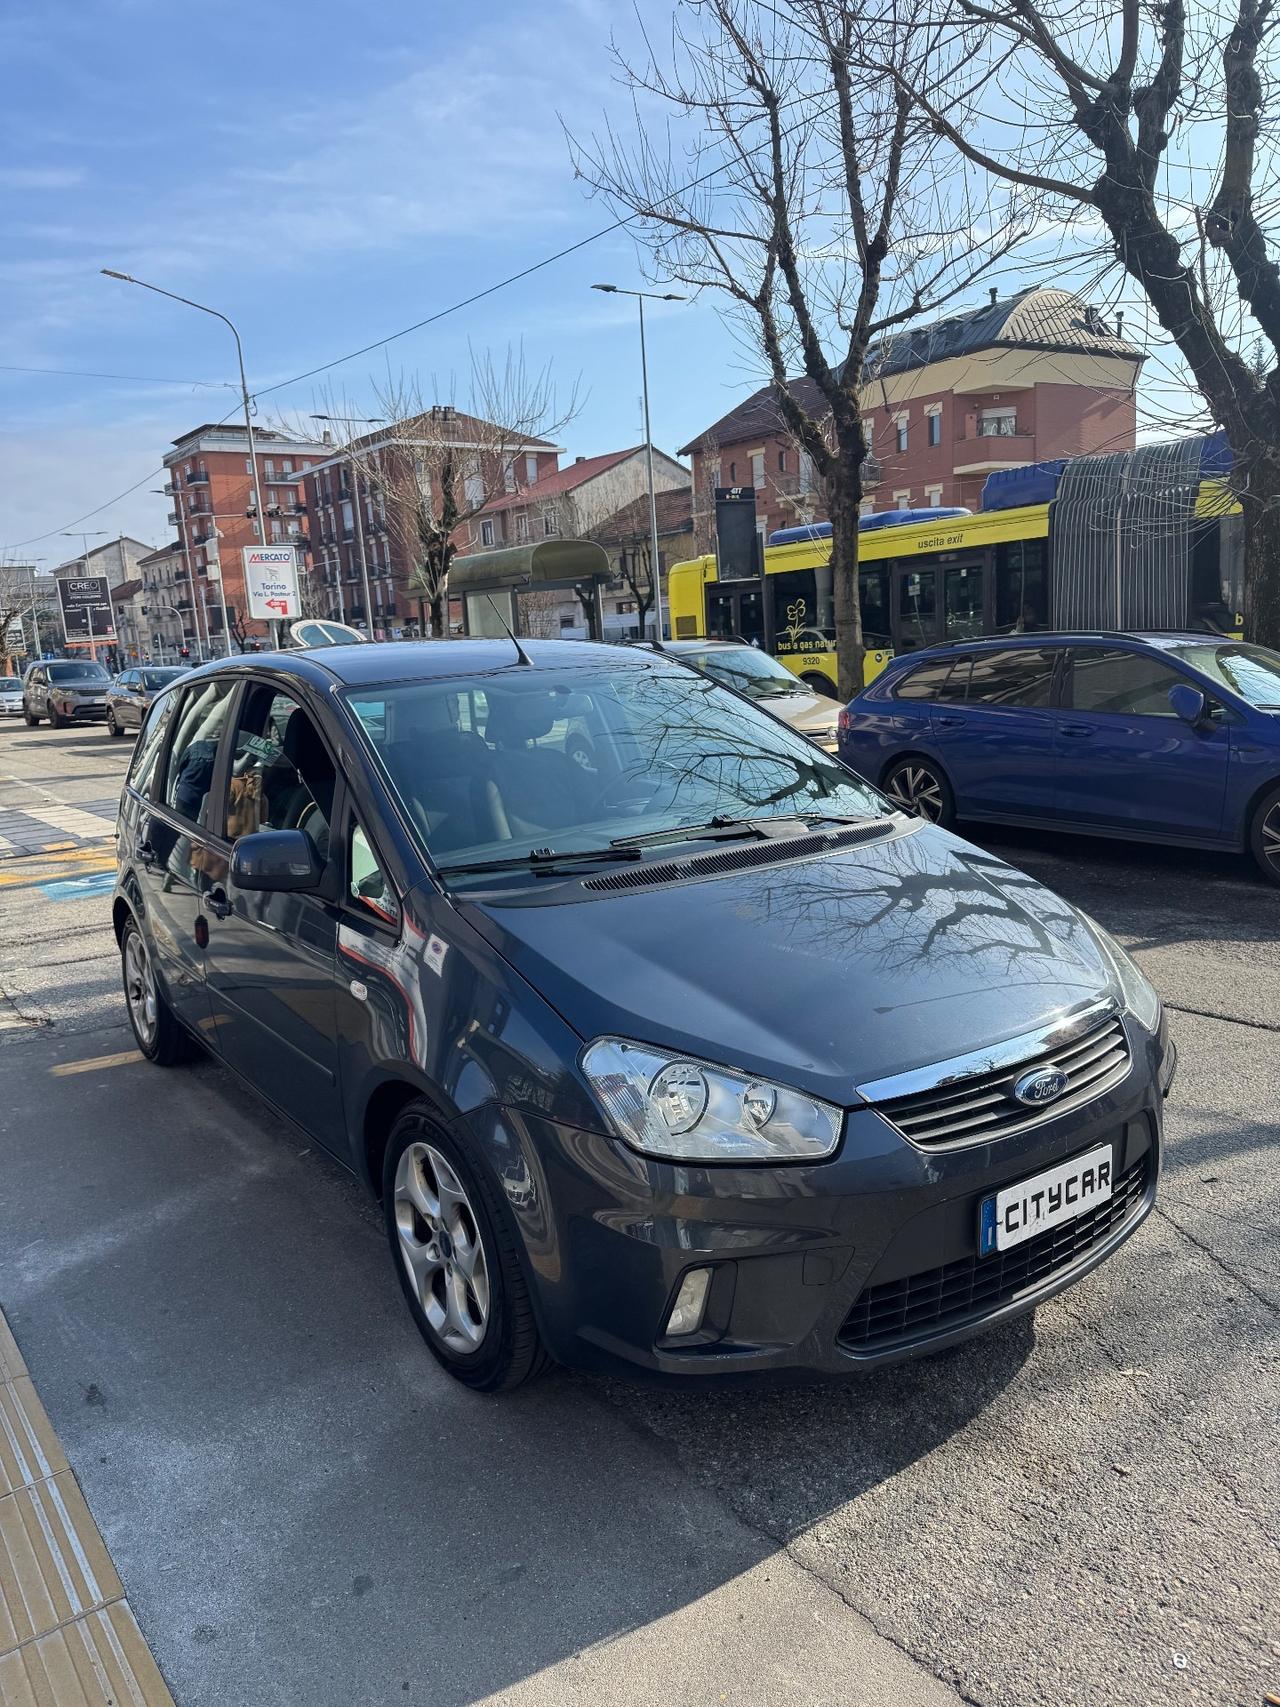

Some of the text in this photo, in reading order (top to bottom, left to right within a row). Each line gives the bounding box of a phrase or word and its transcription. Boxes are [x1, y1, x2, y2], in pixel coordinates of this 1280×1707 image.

[918, 533, 964, 549] uscita exit
[249, 553, 290, 562] MERCATO
[70, 582, 98, 590] CREO
[261, 582, 287, 590] Torino
[778, 642, 791, 650] bus
[799, 641, 813, 651] gas
[815, 640, 838, 648] natur
[803, 657, 820, 665] 9320
[1034, 1077, 1060, 1099] Ford
[1005, 1161, 1110, 1233] CITYCAR
